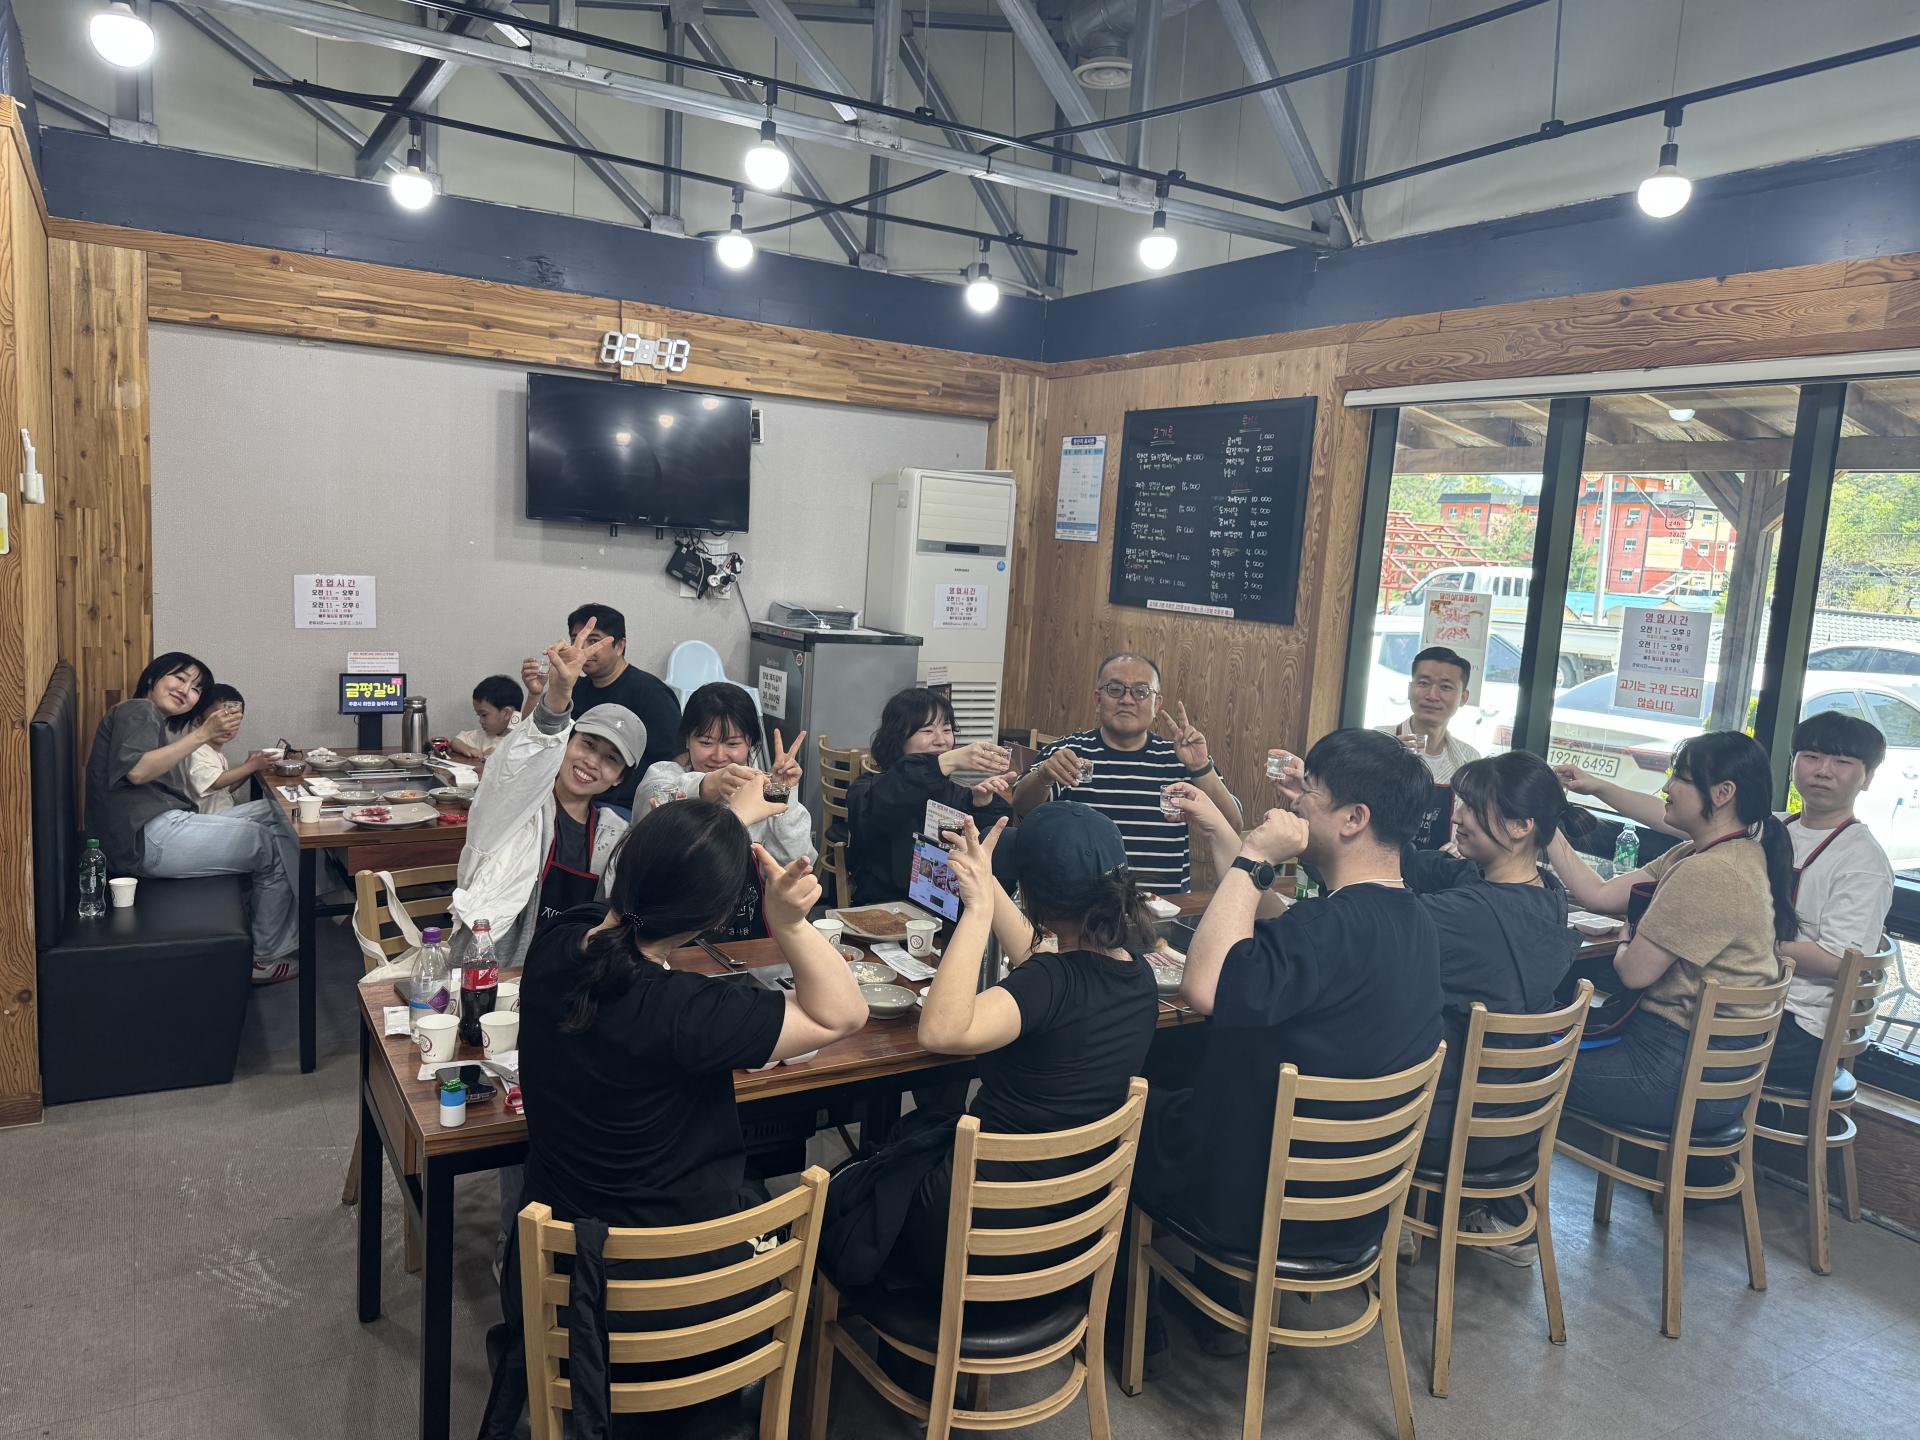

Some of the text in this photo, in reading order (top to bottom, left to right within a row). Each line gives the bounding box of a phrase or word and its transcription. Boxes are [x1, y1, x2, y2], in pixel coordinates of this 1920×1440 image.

[312, 589, 323, 597] 오전
[1639, 625, 1653, 634] 오전
[1672, 628, 1685, 637] 오후
[1638, 640, 1651, 649] 오전
[1669, 644, 1683, 652] 오후
[345, 681, 401, 698] 금평갈비
[1619, 680, 1699, 700] 고기는 구워 드리지
[1637, 697, 1676, 712] 않습니다.
[1582, 755, 1616, 774] 6495
